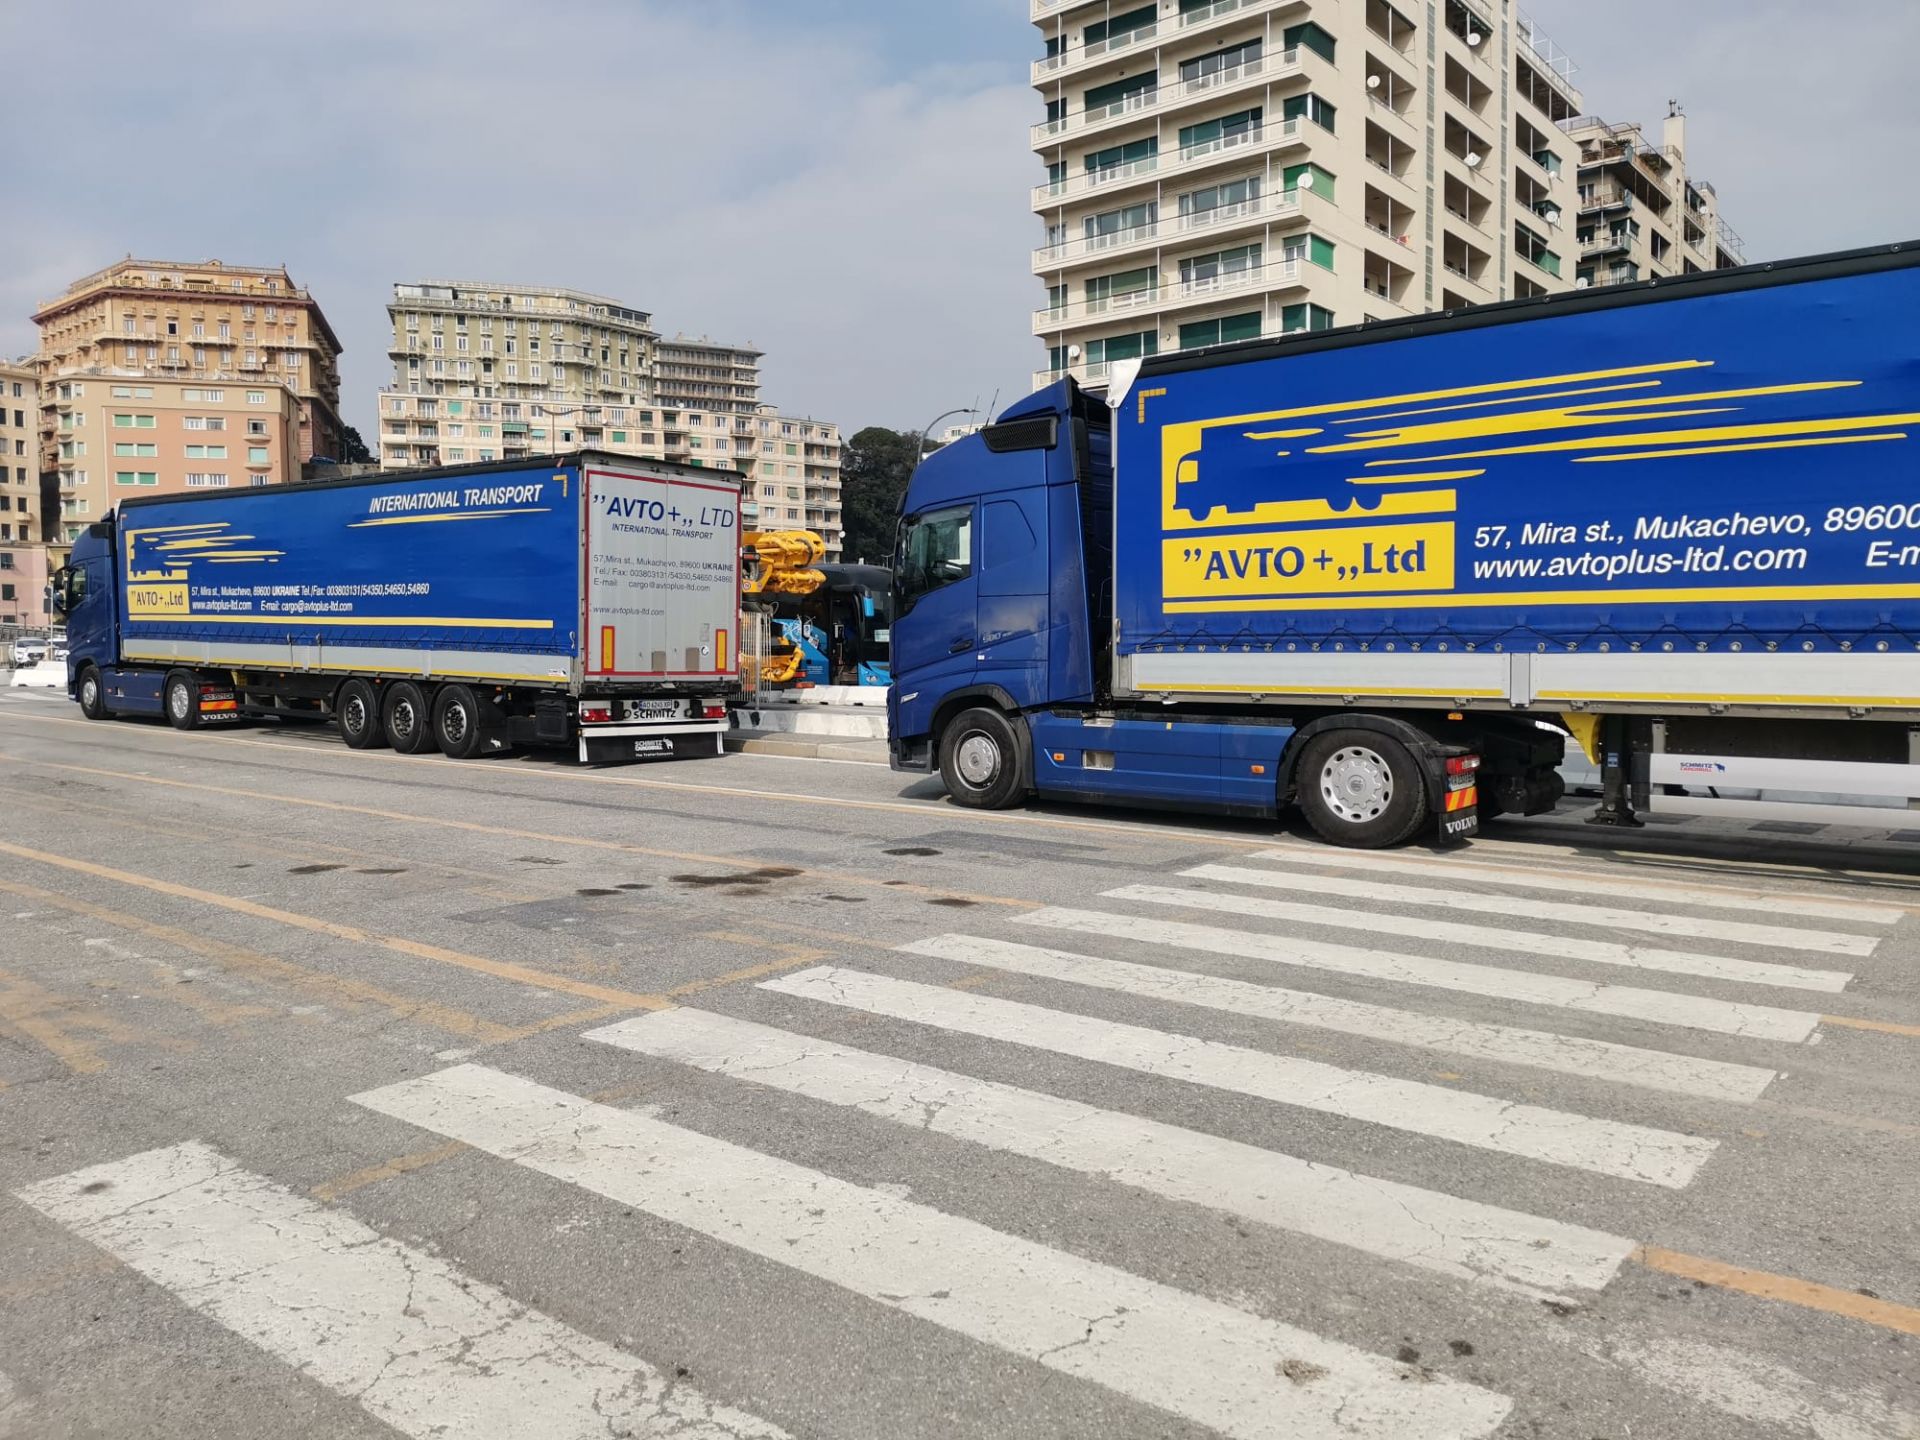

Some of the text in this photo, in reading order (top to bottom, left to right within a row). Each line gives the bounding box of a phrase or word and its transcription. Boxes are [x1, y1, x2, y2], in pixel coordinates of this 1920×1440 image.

[369, 484, 544, 513] INTERNATIONAL TRANSPORT
[700, 506, 734, 528] LTD
[1474, 503, 1920, 549] 57, Mira st., Mukachevo, 89600
[612, 523, 713, 540] INTERNATIONAL TRANSPORT
[702, 562, 734, 572] UKRAINE
[1473, 545, 1807, 580] www.avtoplus-ltd.com
[253, 586, 271, 596] 89600
[272, 585, 300, 596] UKRAINE
[634, 710, 676, 719] SCHMITZ
[1446, 815, 1478, 834] VOLVO
